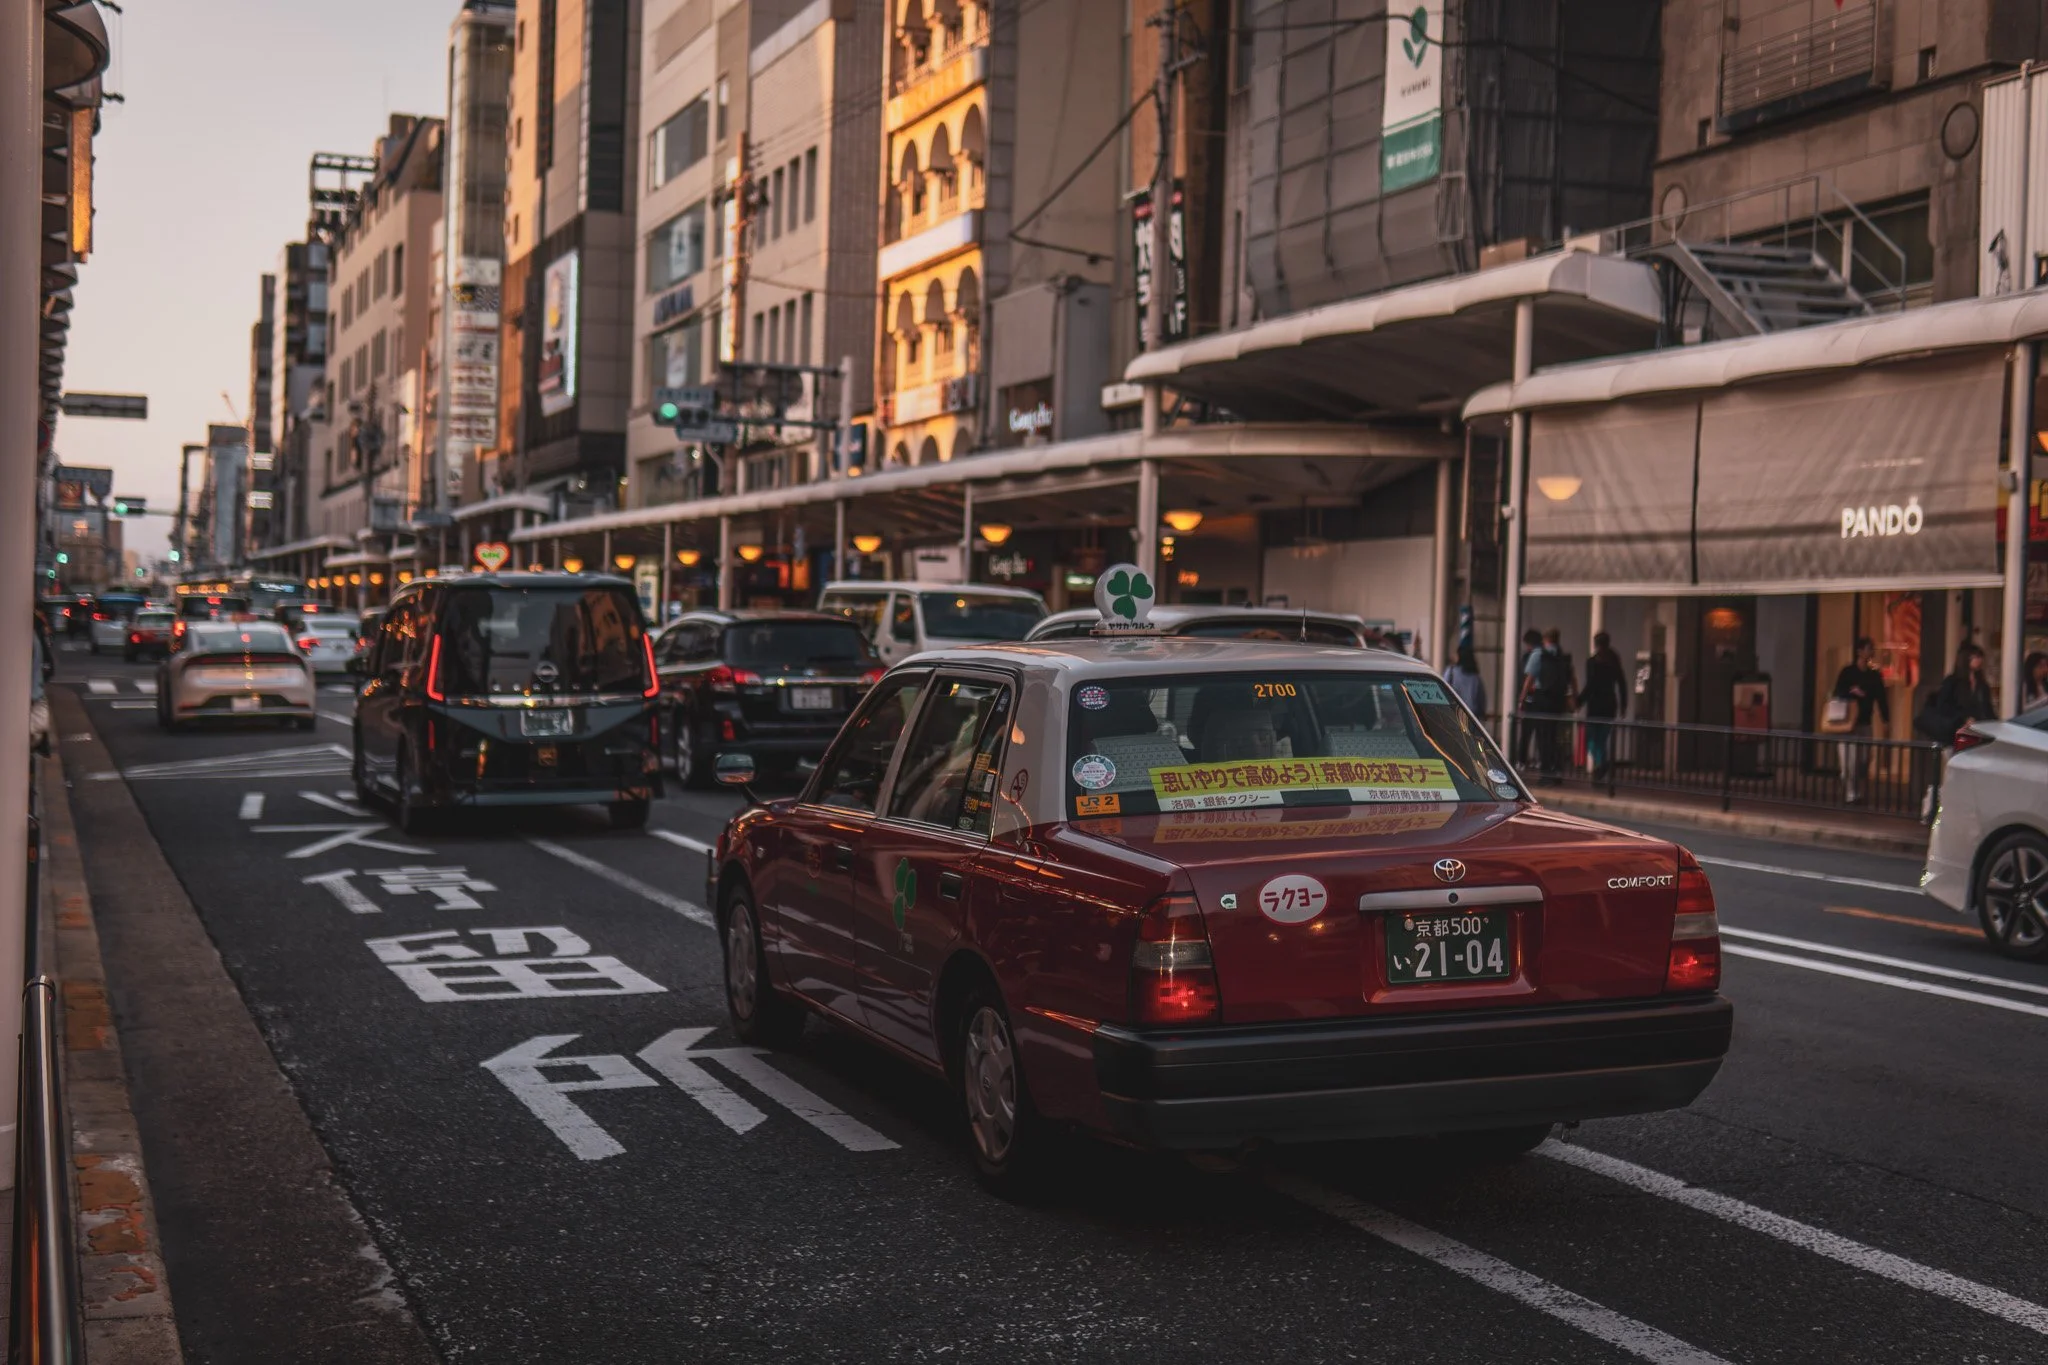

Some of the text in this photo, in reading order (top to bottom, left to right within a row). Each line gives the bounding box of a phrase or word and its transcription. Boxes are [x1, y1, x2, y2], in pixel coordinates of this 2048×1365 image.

[1254, 683, 1296, 698] 2700
[1080, 796, 1115, 808] JR 2
[1607, 874, 1674, 889] COMFORT
[1264, 886, 1324, 912] ラクヨー
[1393, 938, 1504, 978] い 21-04
